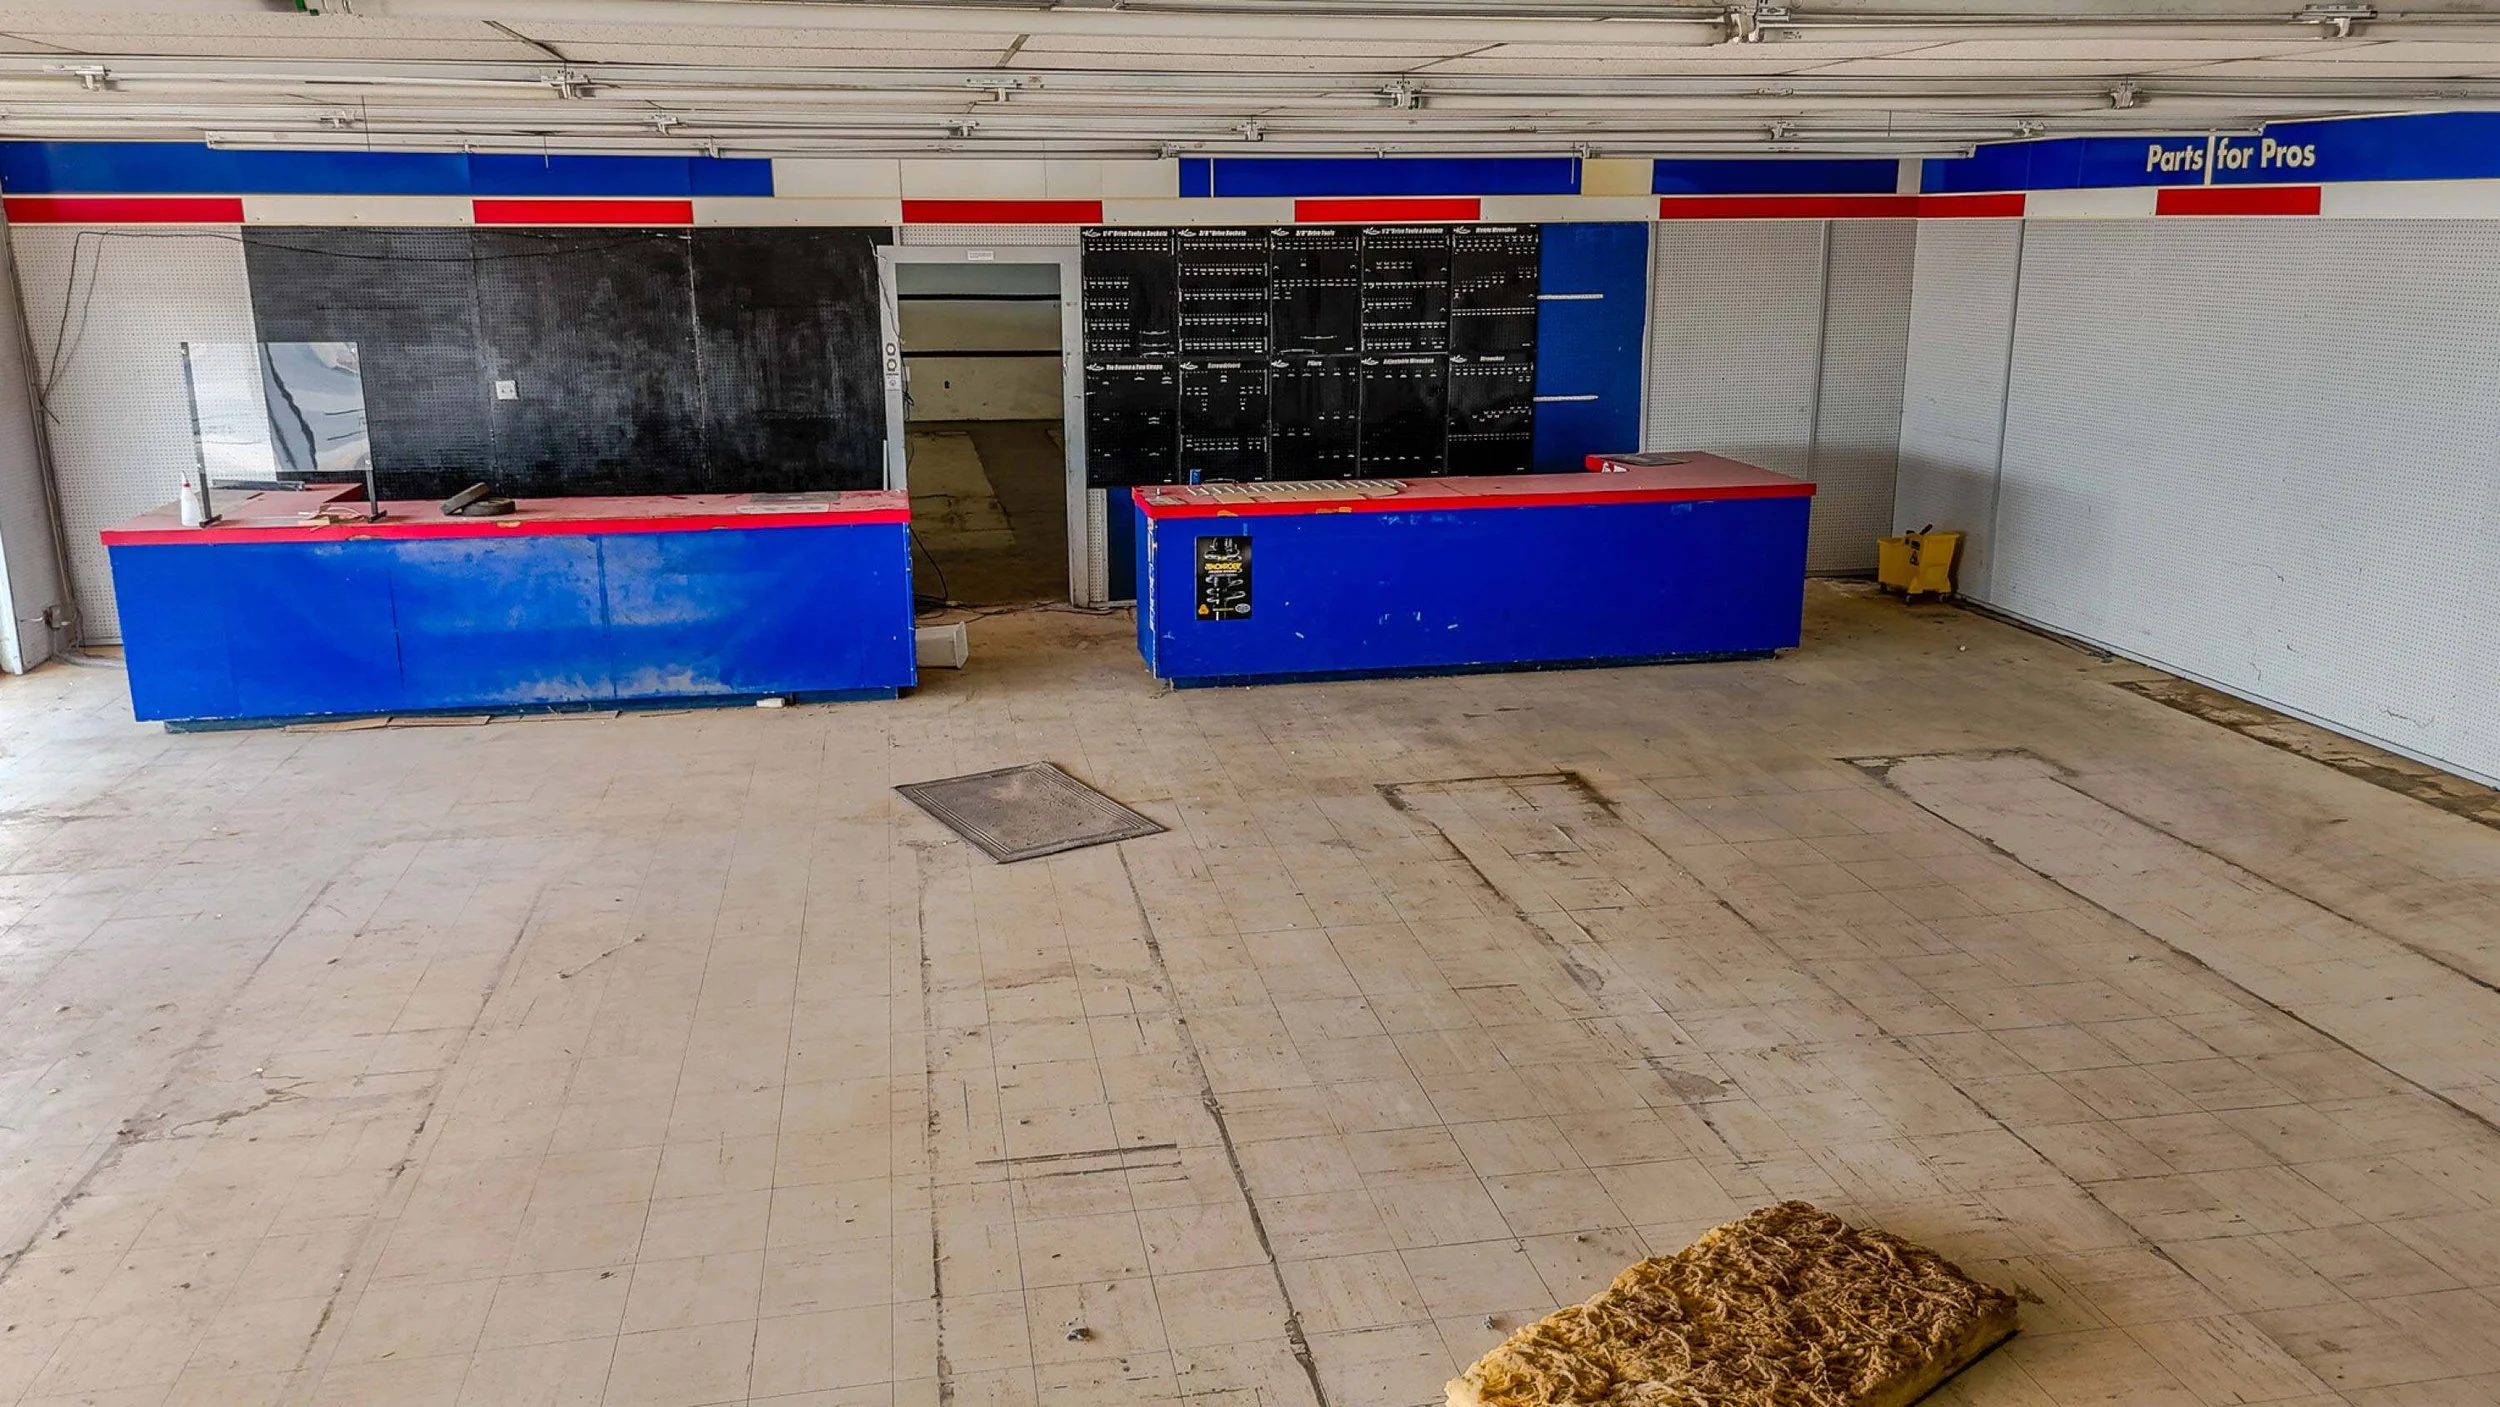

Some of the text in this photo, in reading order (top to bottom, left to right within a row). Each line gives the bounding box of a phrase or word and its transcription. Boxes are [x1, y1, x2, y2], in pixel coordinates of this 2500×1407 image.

[2146, 138, 2316, 172] Parts for Pros
